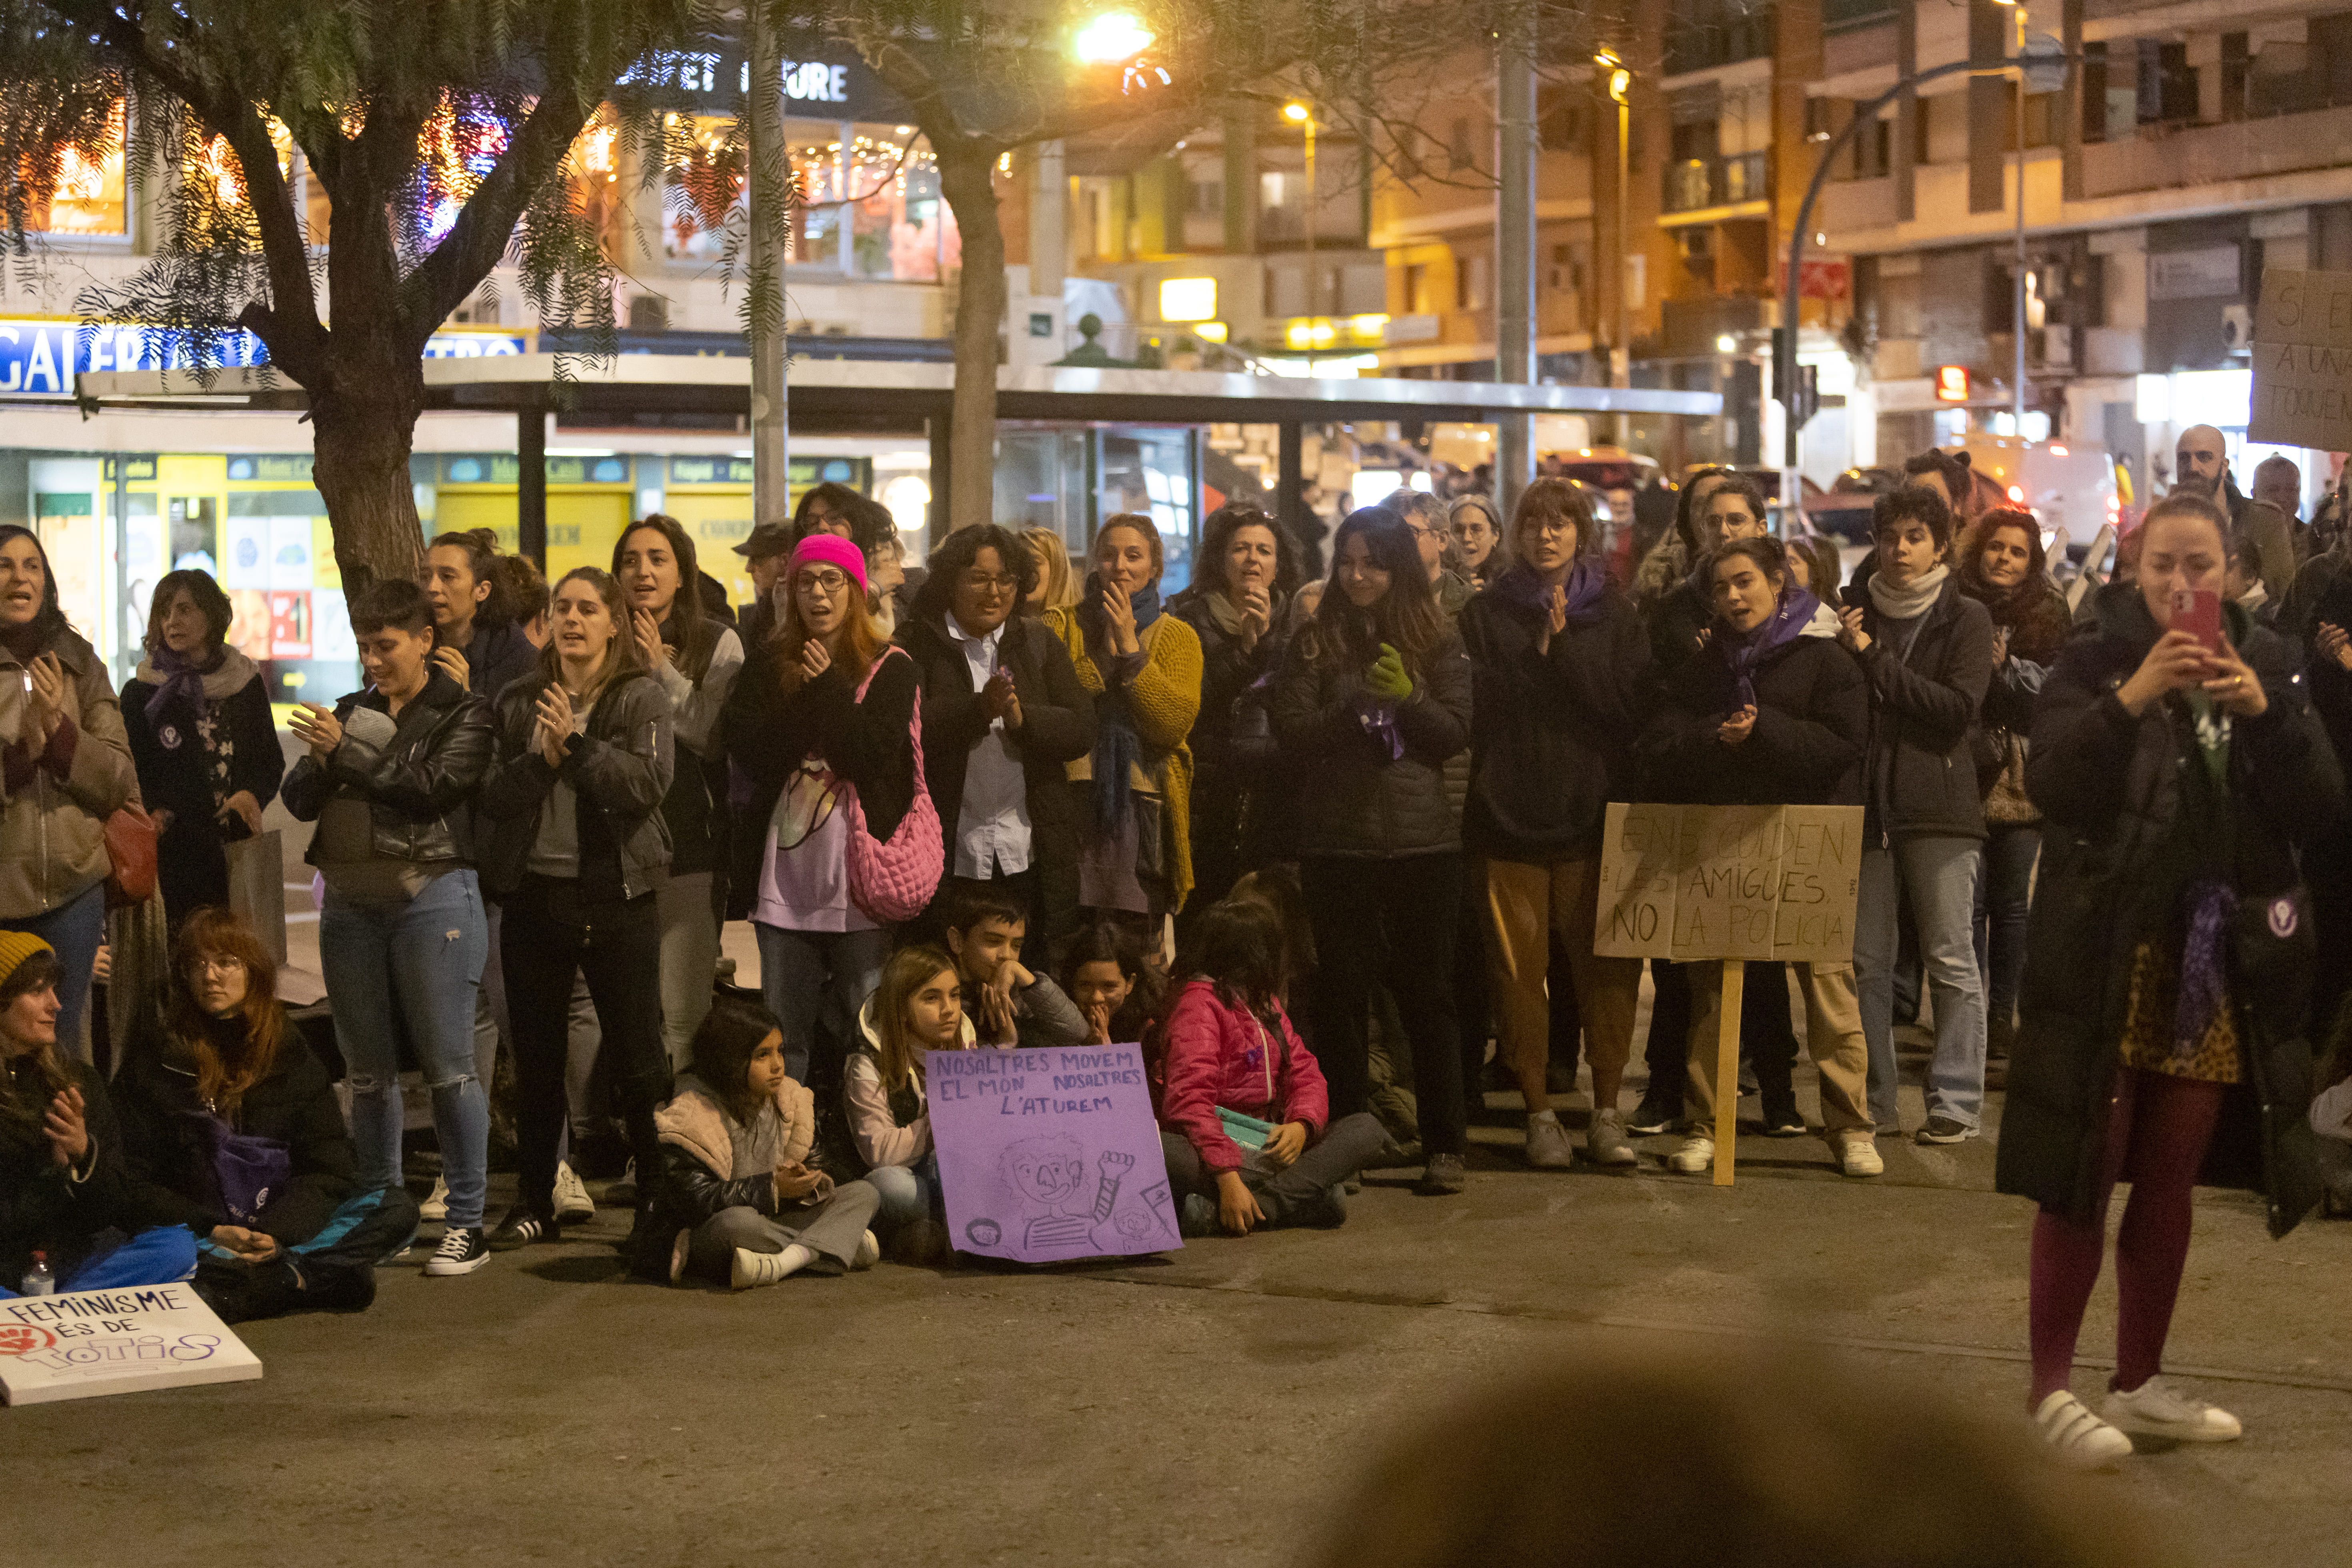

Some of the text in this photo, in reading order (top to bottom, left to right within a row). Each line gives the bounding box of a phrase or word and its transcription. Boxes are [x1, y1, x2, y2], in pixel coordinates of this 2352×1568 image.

[1613, 903, 1658, 942] NO
[1672, 906, 1707, 946] LA
[936, 1052, 1133, 1076] NOSALTRES MOVEM
[940, 1079, 969, 1101] EL
[1053, 1069, 1141, 1091] NOSALTRES
[1000, 1095, 1113, 1115] L'ATUREM
[54, 1319, 141, 1338] ÉS DE
